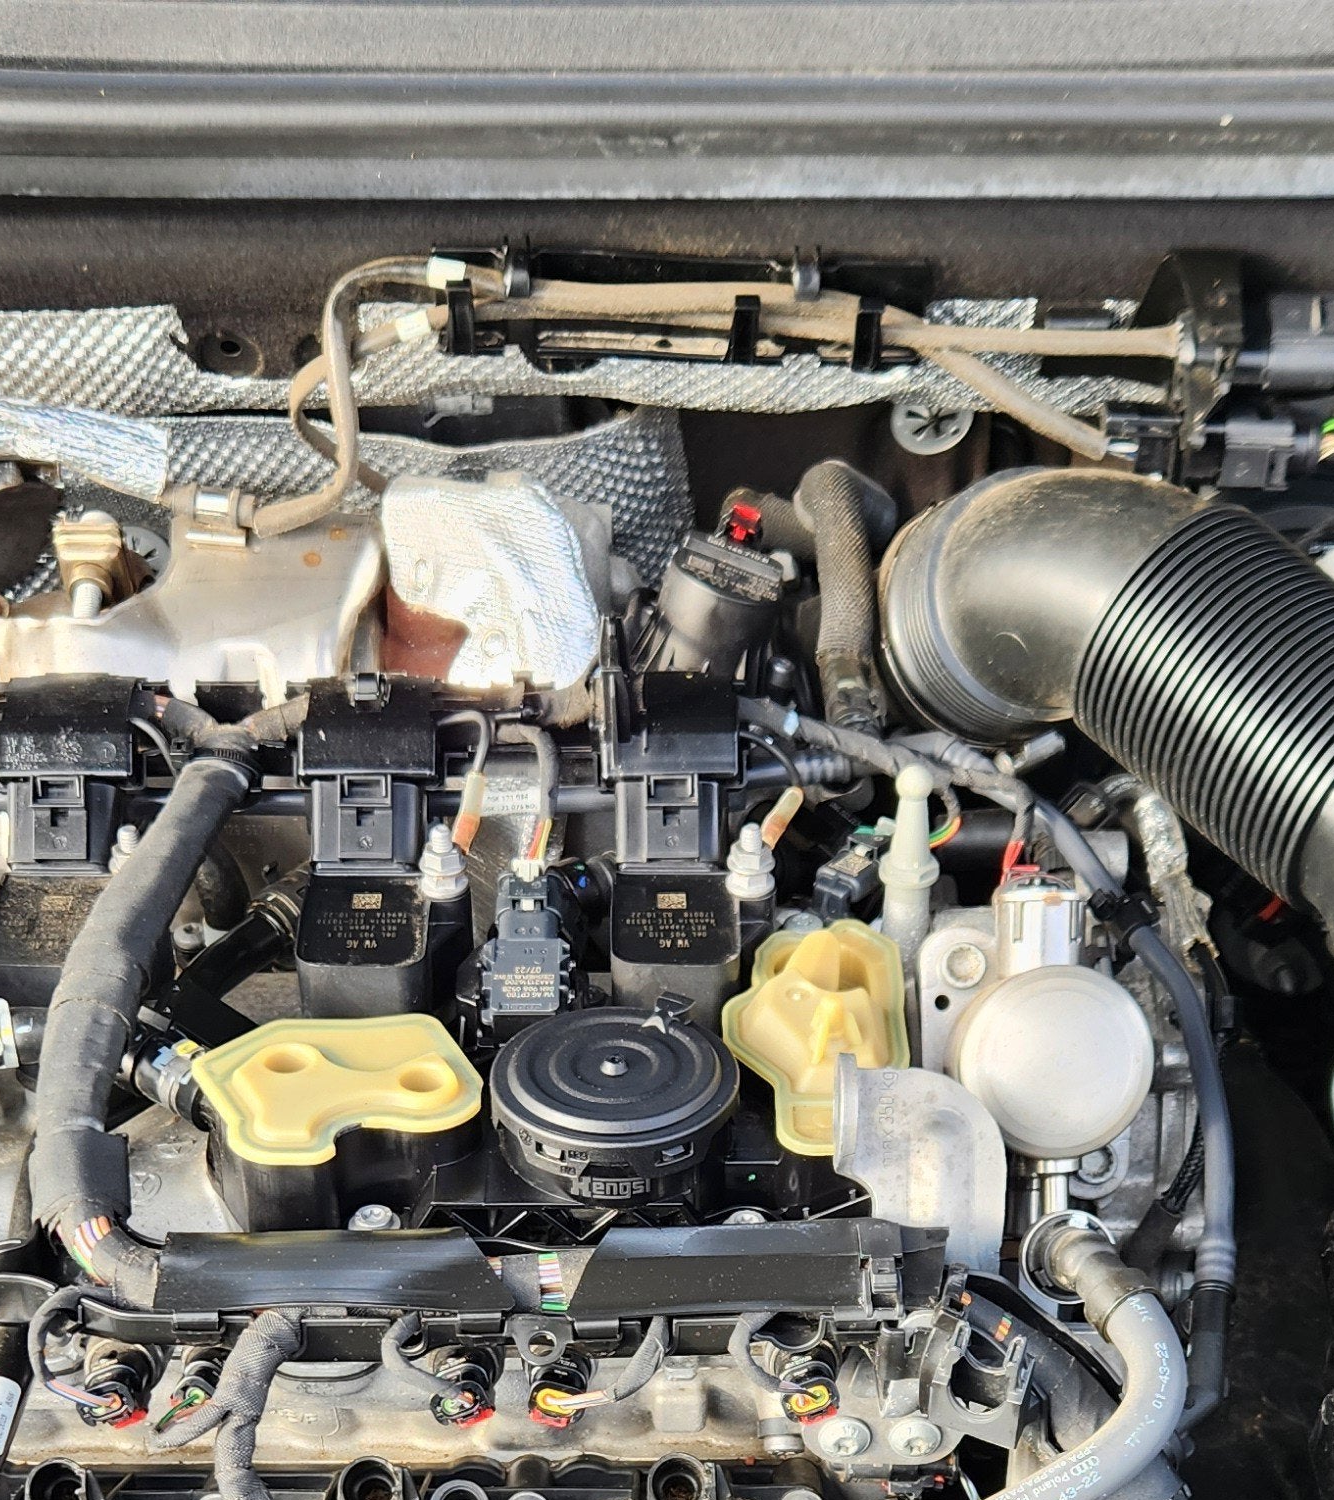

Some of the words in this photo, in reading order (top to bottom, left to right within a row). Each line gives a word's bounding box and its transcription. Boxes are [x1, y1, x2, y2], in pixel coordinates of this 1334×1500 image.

[346, 940, 359, 949] AG
[364, 940, 377, 949] VW
[659, 939, 672, 948] AG
[677, 939, 690, 948] VW
[1152, 1341, 1169, 1409] 01-43-22
[1033, 1471, 1070, 1498] Poland
